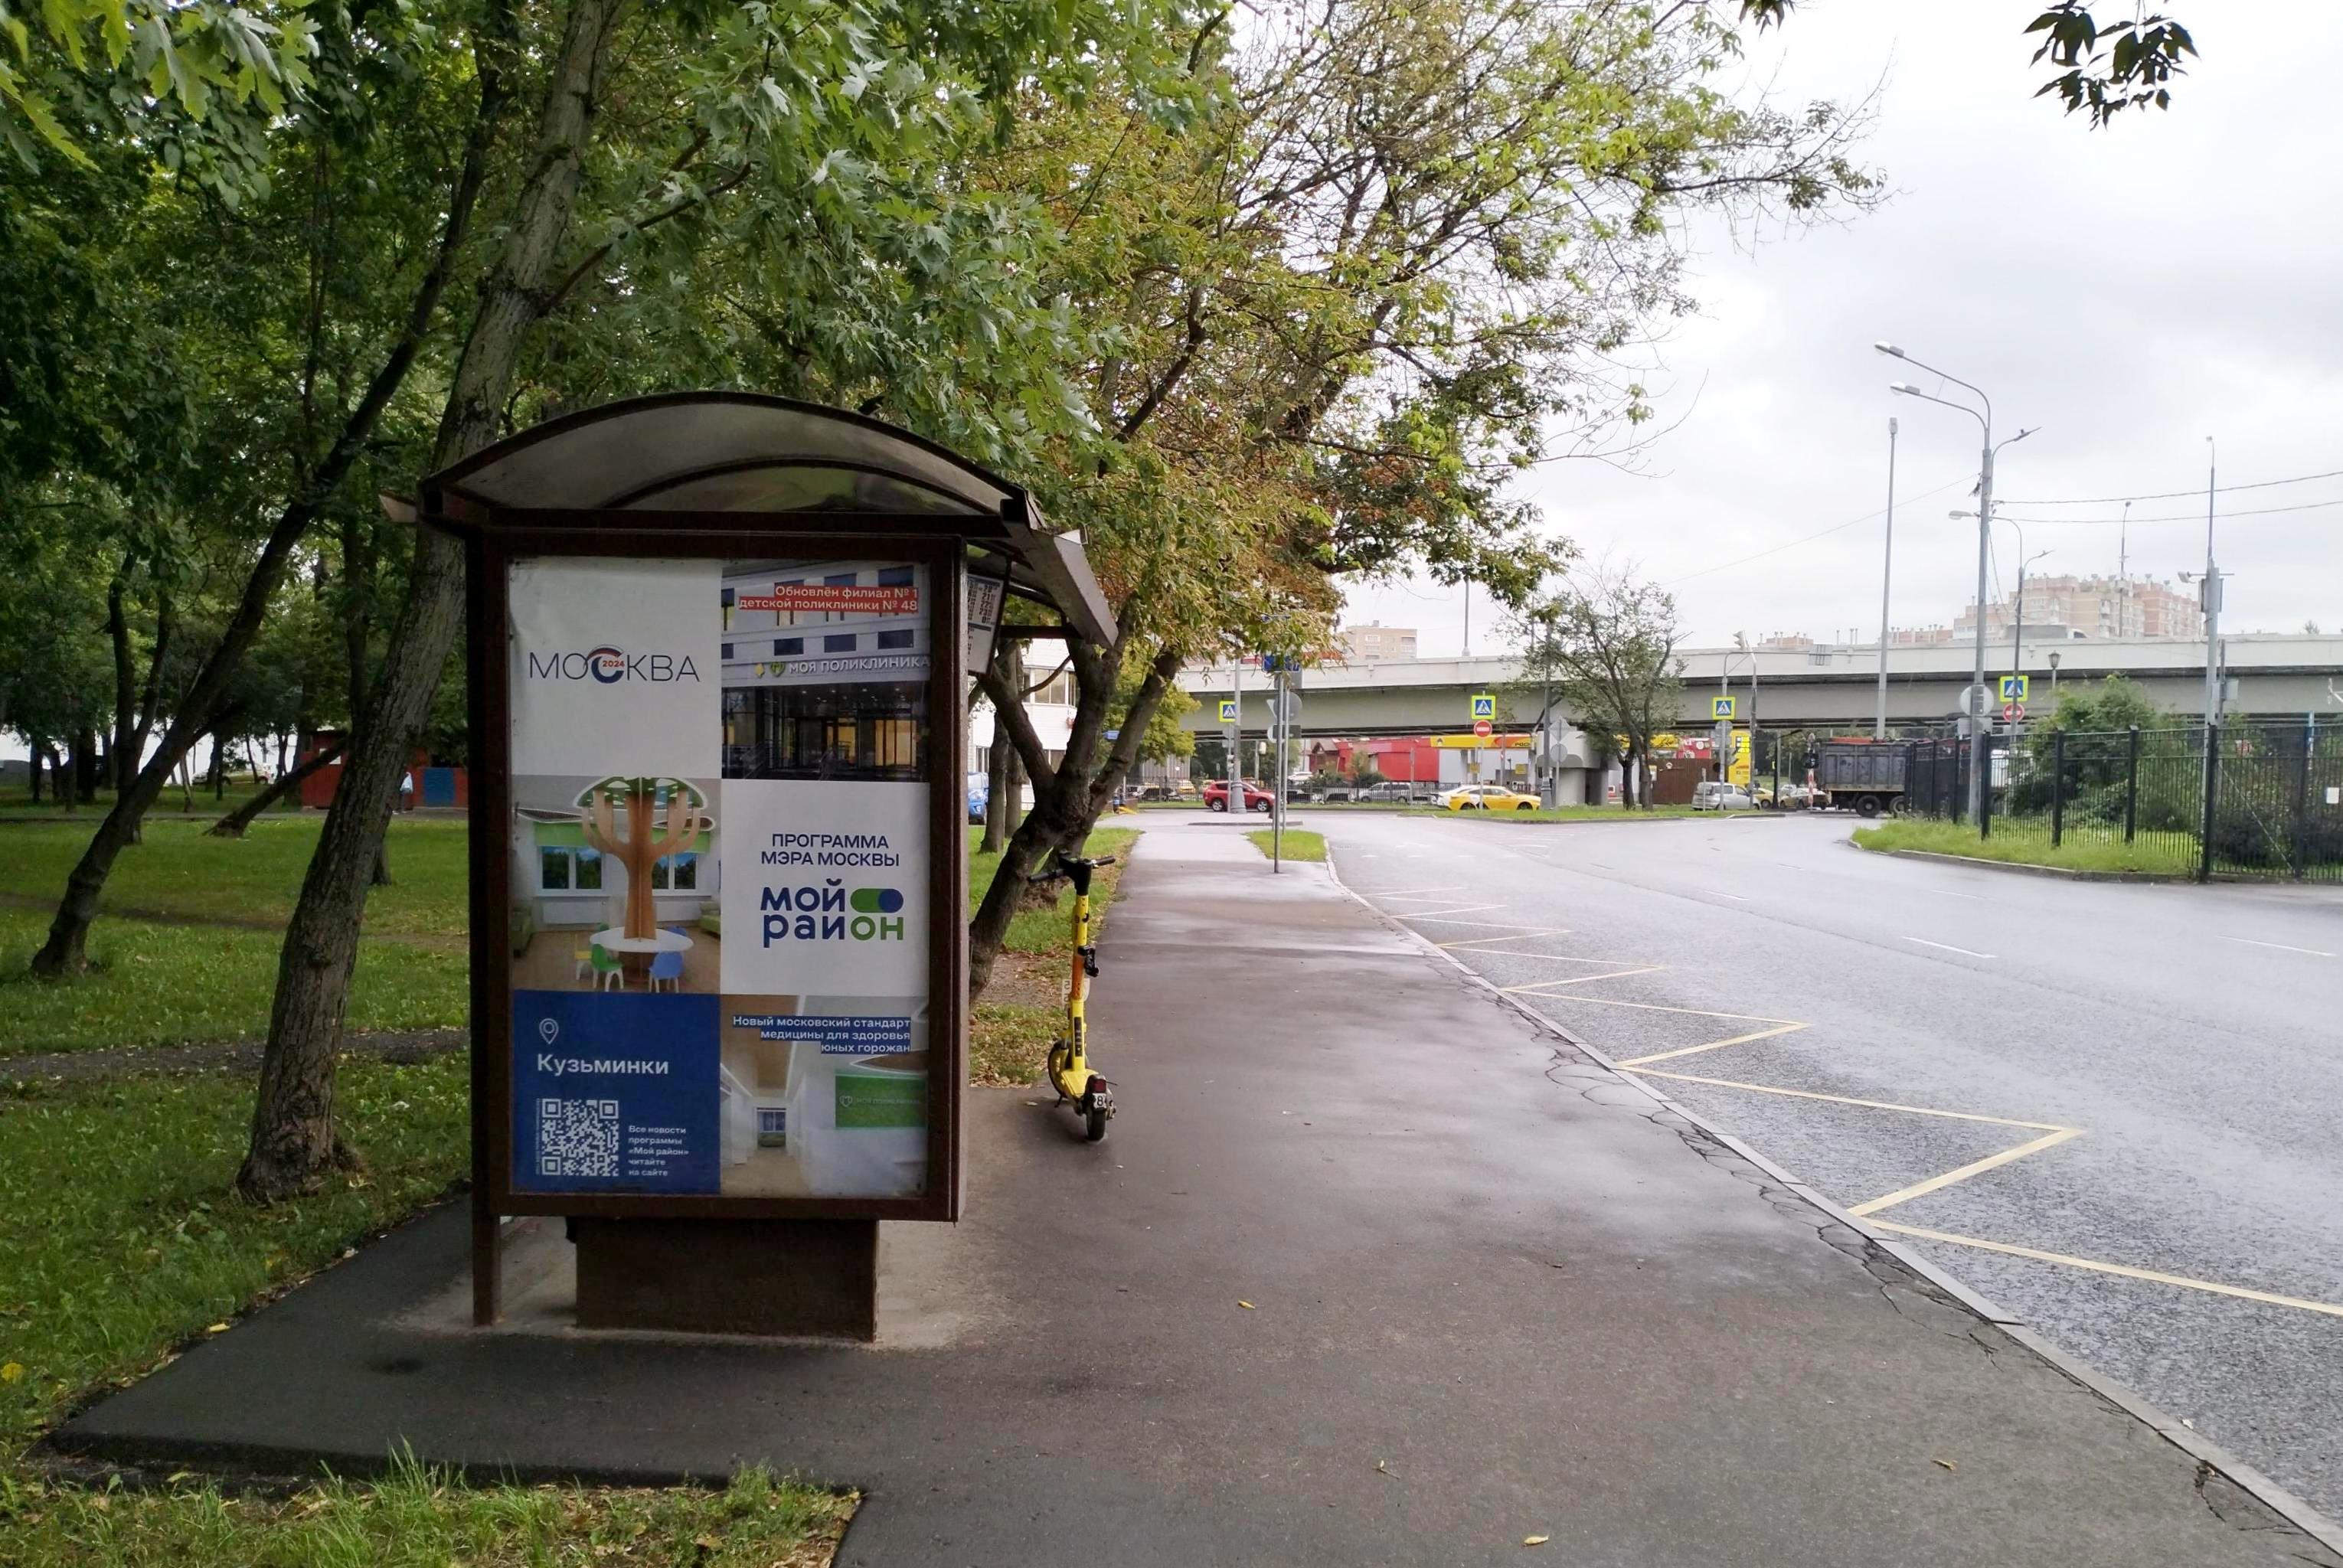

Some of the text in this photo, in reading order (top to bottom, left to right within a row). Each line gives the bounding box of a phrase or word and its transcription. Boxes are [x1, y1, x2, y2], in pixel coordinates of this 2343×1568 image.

[775, 586, 917, 599] Обновлён филиал № 1
[740, 598, 917, 610] детской поликлиники № 48
[529, 645, 700, 684] МОСКВА
[789, 656, 930, 674] МОЯ ПОЛИКЛИНИКА
[772, 833, 889, 848] ПРОГРАММА
[761, 851, 900, 867] МЭРА МОСКВЫ
[760, 878, 845, 913] мой
[733, 1016, 911, 1030] Новый московский стандарт
[760, 1031, 910, 1041] медицины для здоровья
[821, 1044, 910, 1054] юных горожан
[538, 1054, 668, 1076] Кузьминки
[629, 1125, 646, 1133] Все
[628, 1137, 682, 1145] программы
[655, 1148, 689, 1157] район»
[628, 1158, 666, 1166] читайте
[641, 1168, 668, 1177] сайте
